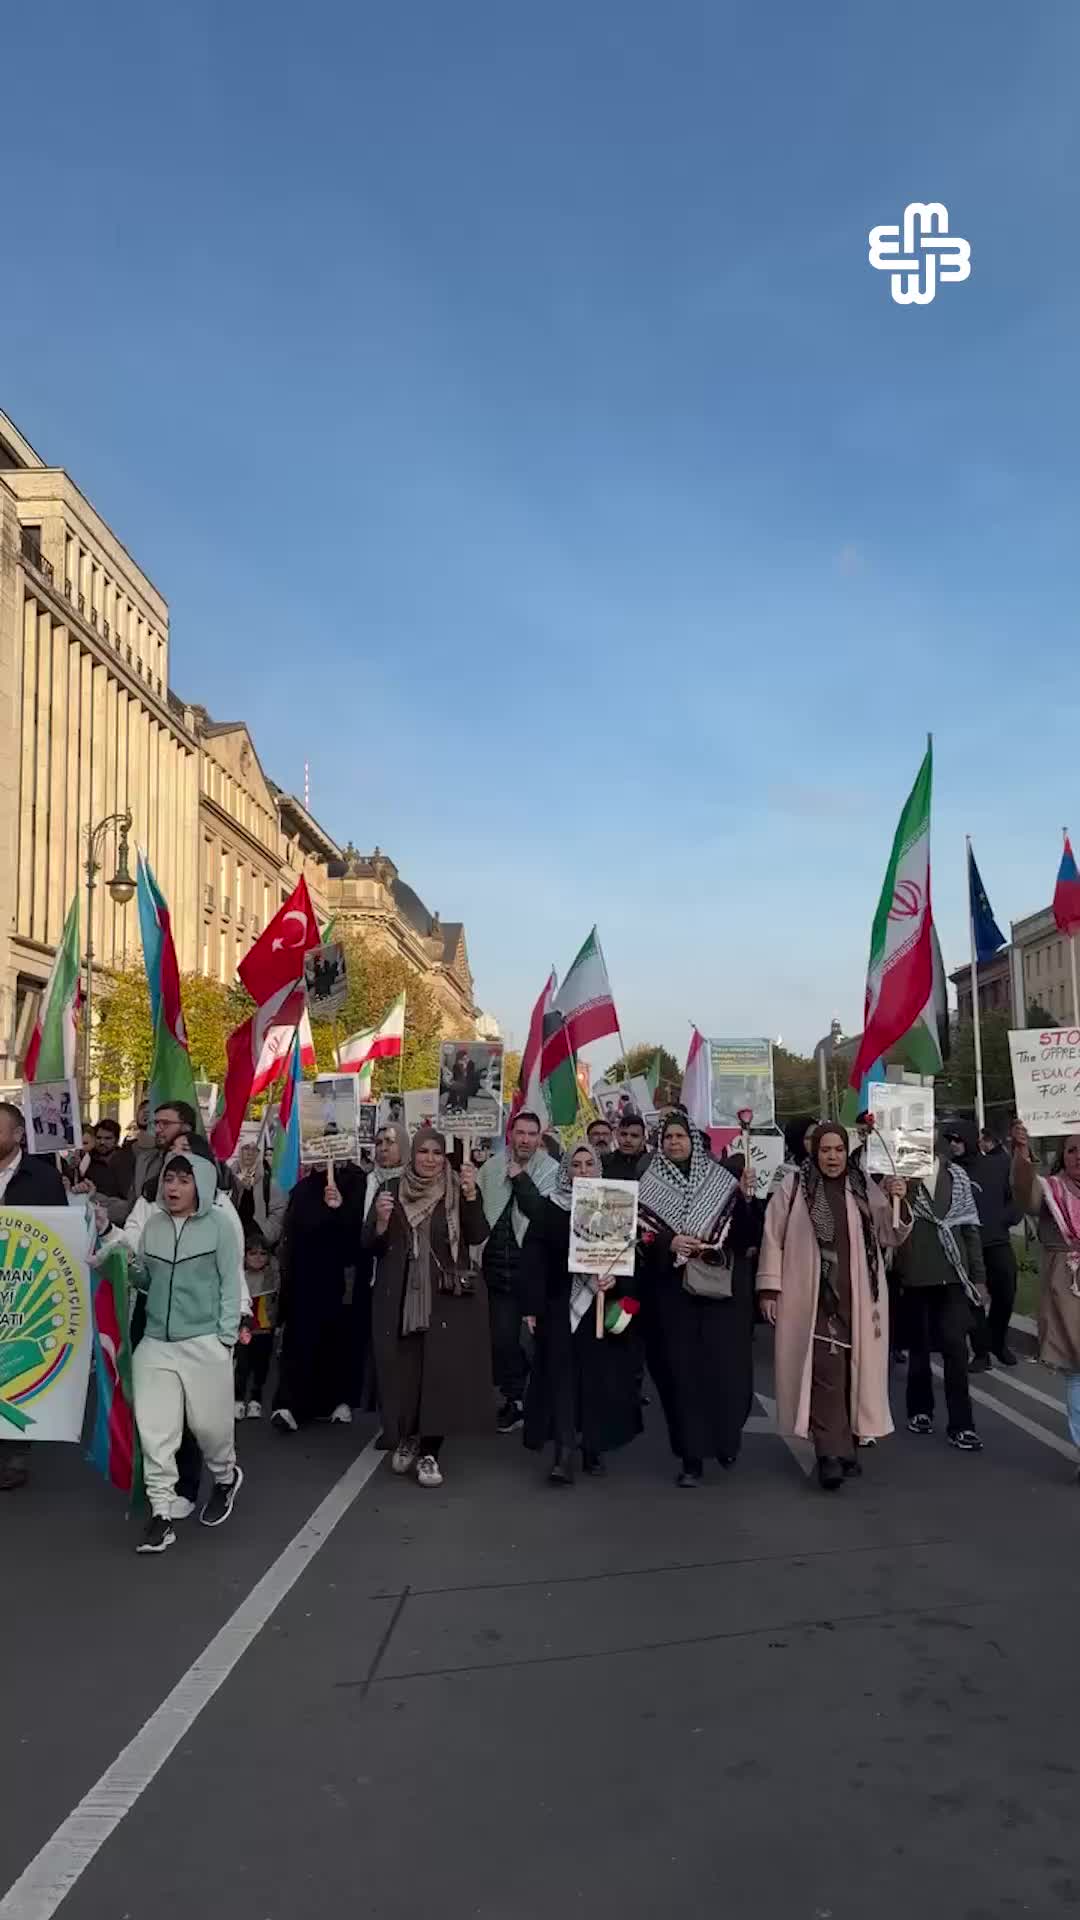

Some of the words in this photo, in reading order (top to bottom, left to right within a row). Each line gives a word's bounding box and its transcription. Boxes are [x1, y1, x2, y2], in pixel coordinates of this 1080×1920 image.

[1016, 1051, 1036, 1063] The
[1041, 1046, 1080, 1060] OPPRE
[1037, 1084, 1067, 1099] FOR
